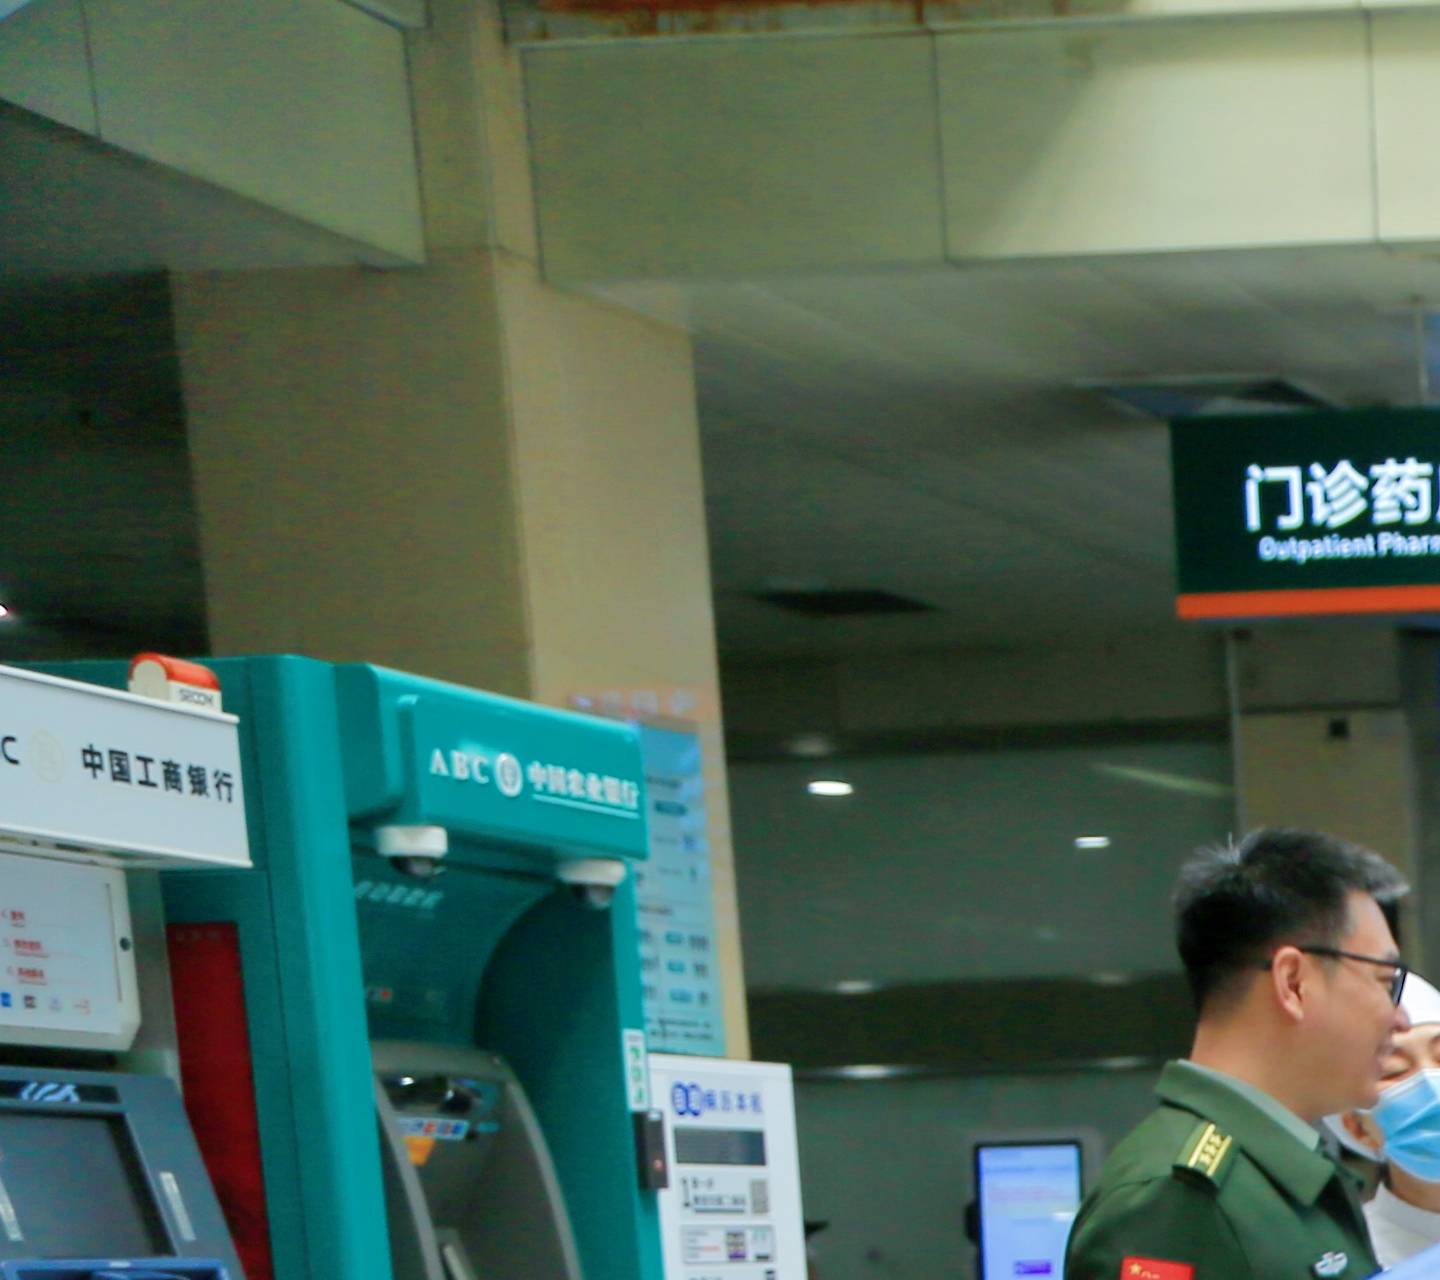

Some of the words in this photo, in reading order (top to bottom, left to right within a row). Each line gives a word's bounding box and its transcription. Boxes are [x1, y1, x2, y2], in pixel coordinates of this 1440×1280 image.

[1258, 534, 1376, 565] Outpatient
[81, 744, 234, 804] 中国工商银行
[429, 748, 490, 785] ABC
